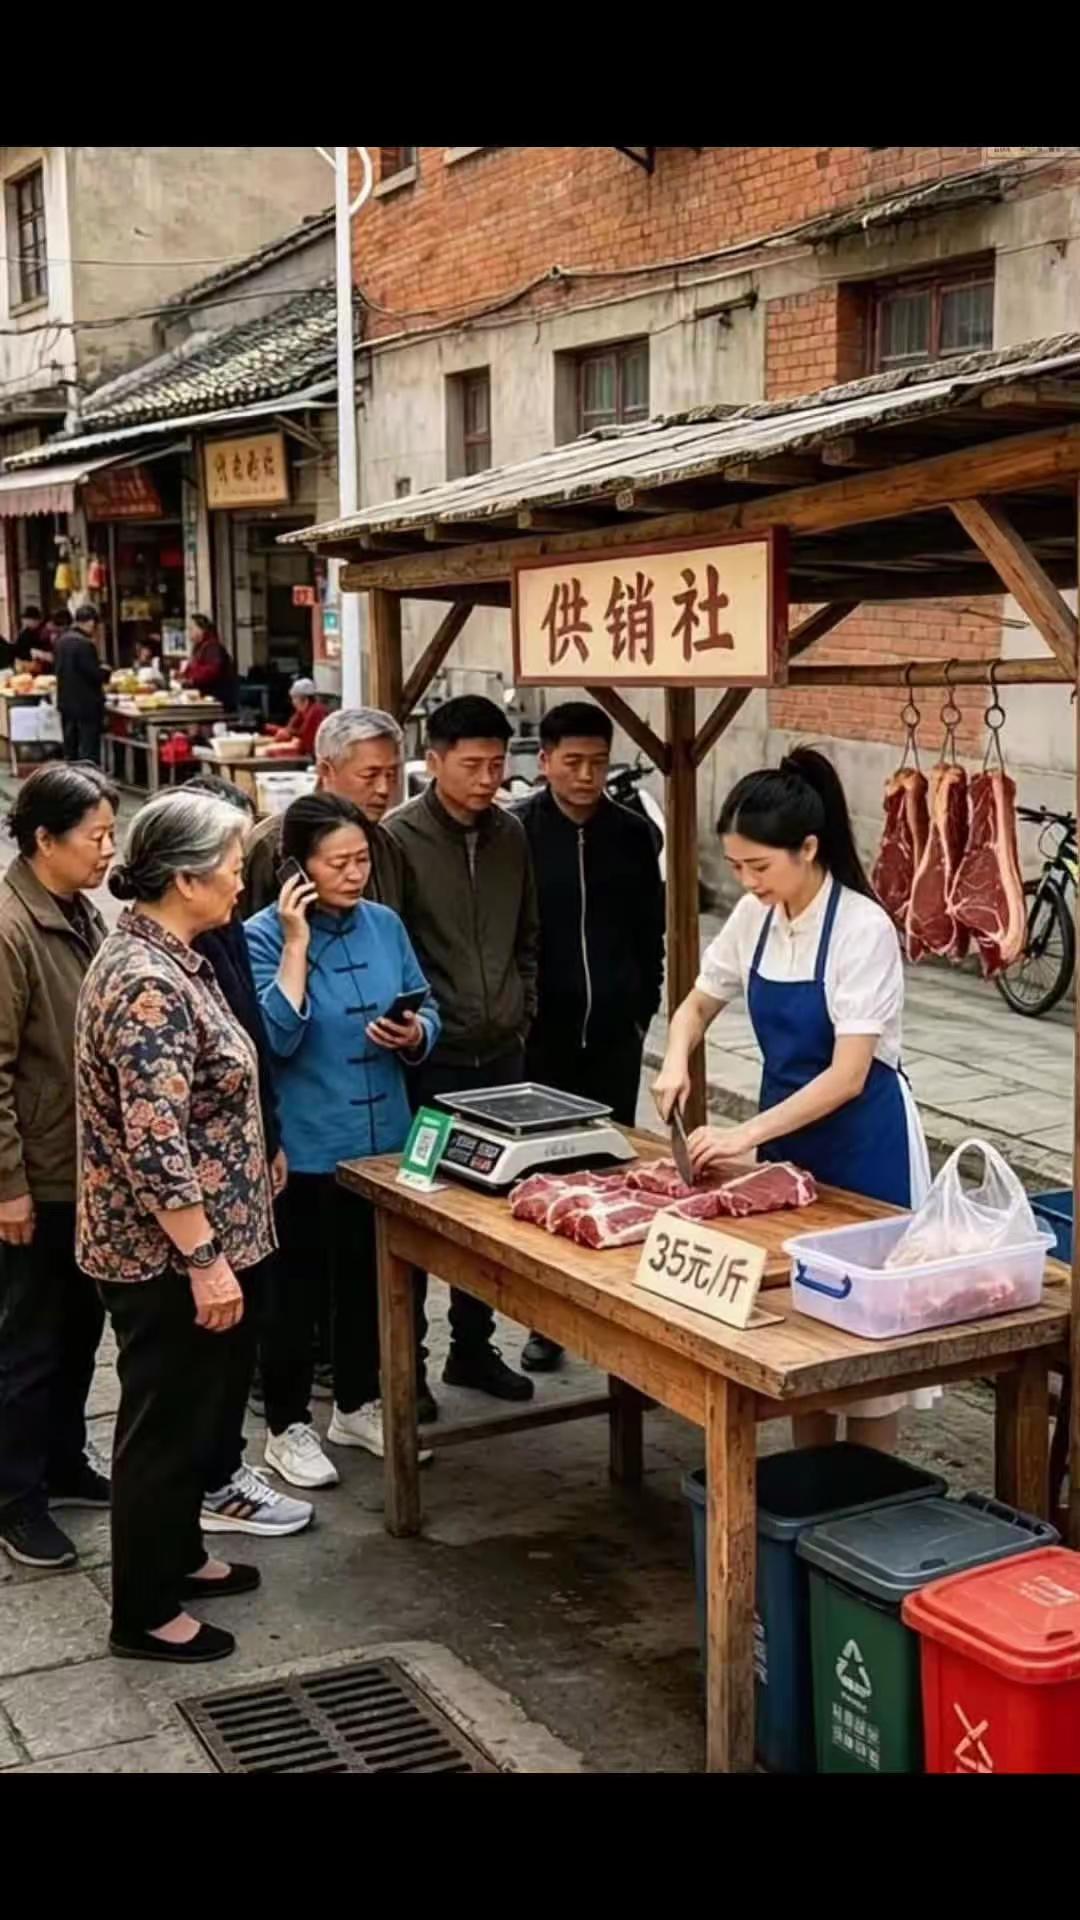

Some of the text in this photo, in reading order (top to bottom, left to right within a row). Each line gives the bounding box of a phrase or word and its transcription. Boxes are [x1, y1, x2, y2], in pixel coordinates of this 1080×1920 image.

[541, 563, 735, 666] 供销社
[648, 1232, 750, 1303] 35元/斤
